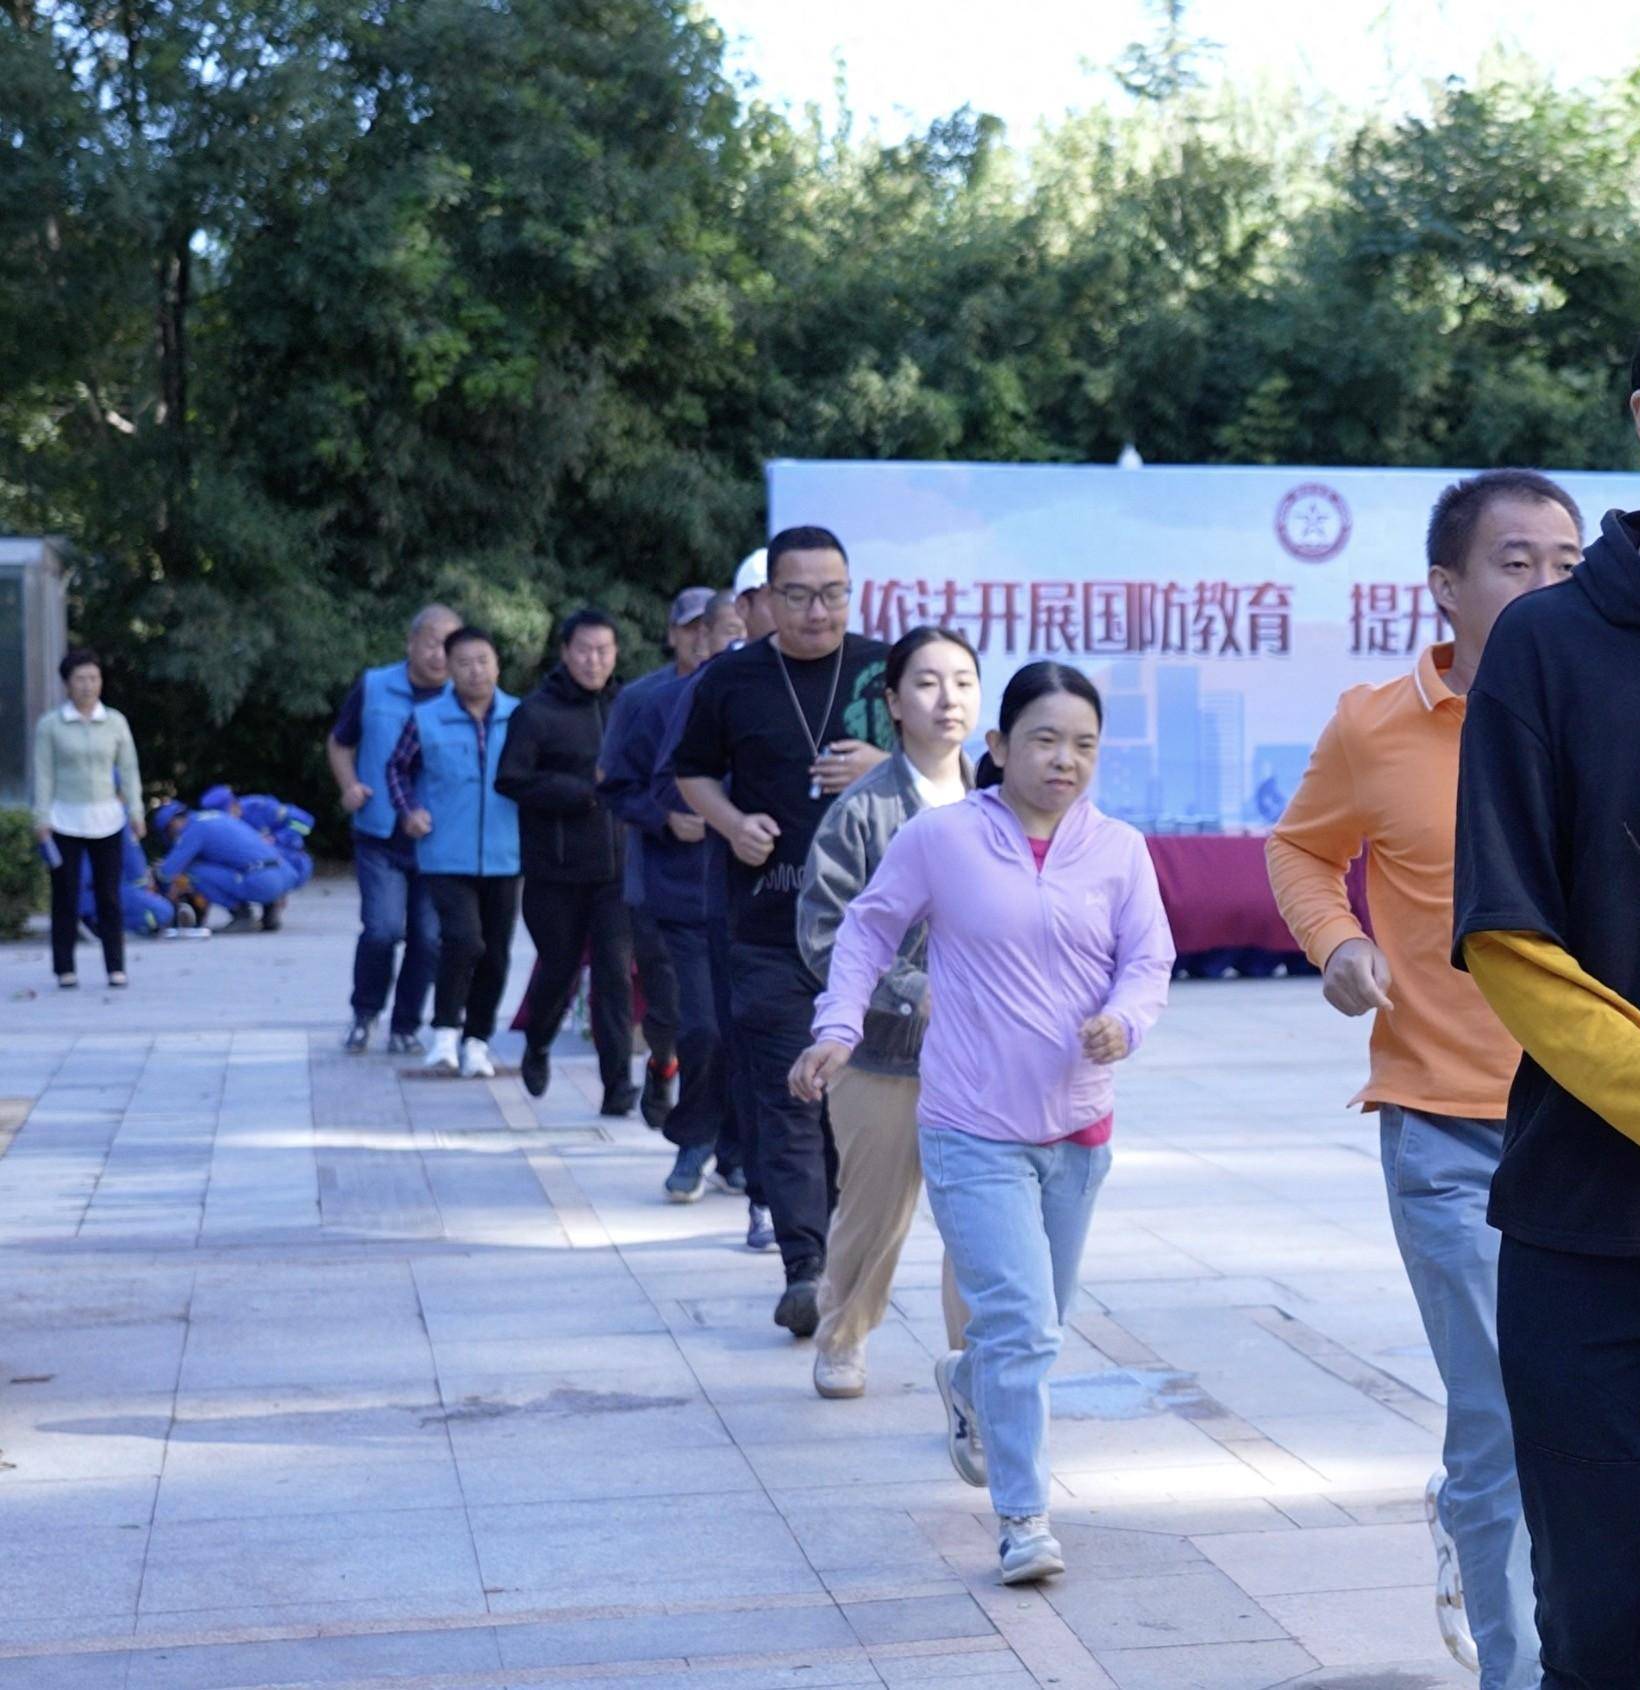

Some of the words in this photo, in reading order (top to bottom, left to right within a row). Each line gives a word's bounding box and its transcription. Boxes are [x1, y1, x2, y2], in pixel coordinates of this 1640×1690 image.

[860, 579, 1294, 655] 依法开展国防教育
